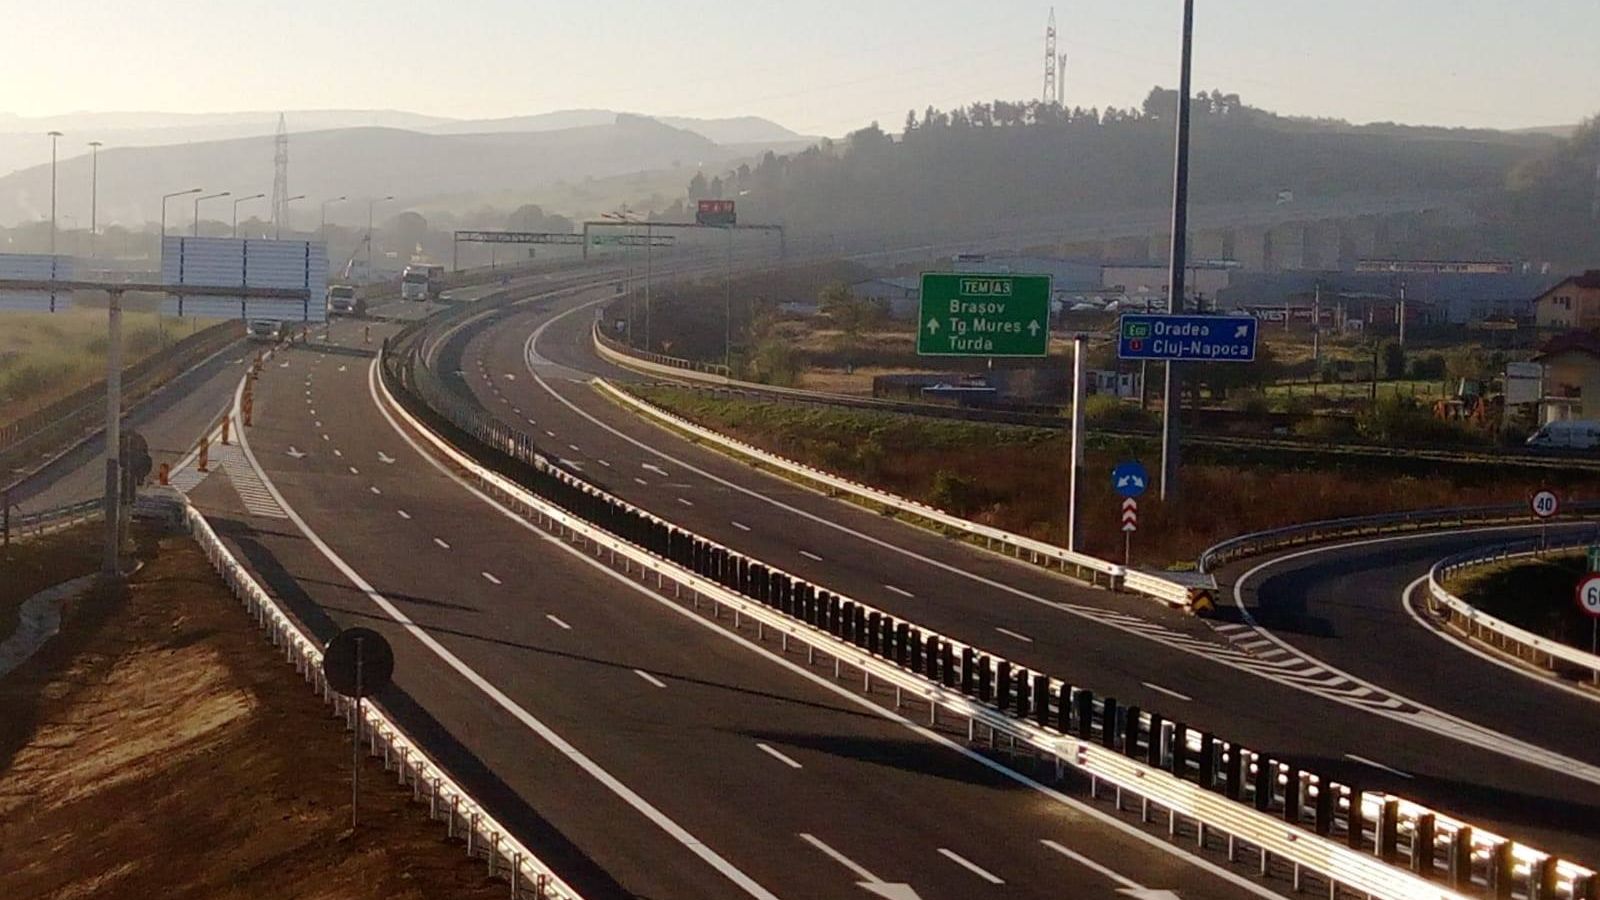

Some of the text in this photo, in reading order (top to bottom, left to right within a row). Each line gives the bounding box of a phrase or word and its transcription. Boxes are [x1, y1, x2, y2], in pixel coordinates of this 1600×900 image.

[963, 282, 1010, 293] TEM A3
[1153, 321, 1210, 336] Oradea
[948, 335, 993, 350] Turda
[1152, 339, 1249, 358] Cluj-Napoca
[1536, 497, 1553, 511] 40
[1587, 586, 1600, 606] 6
